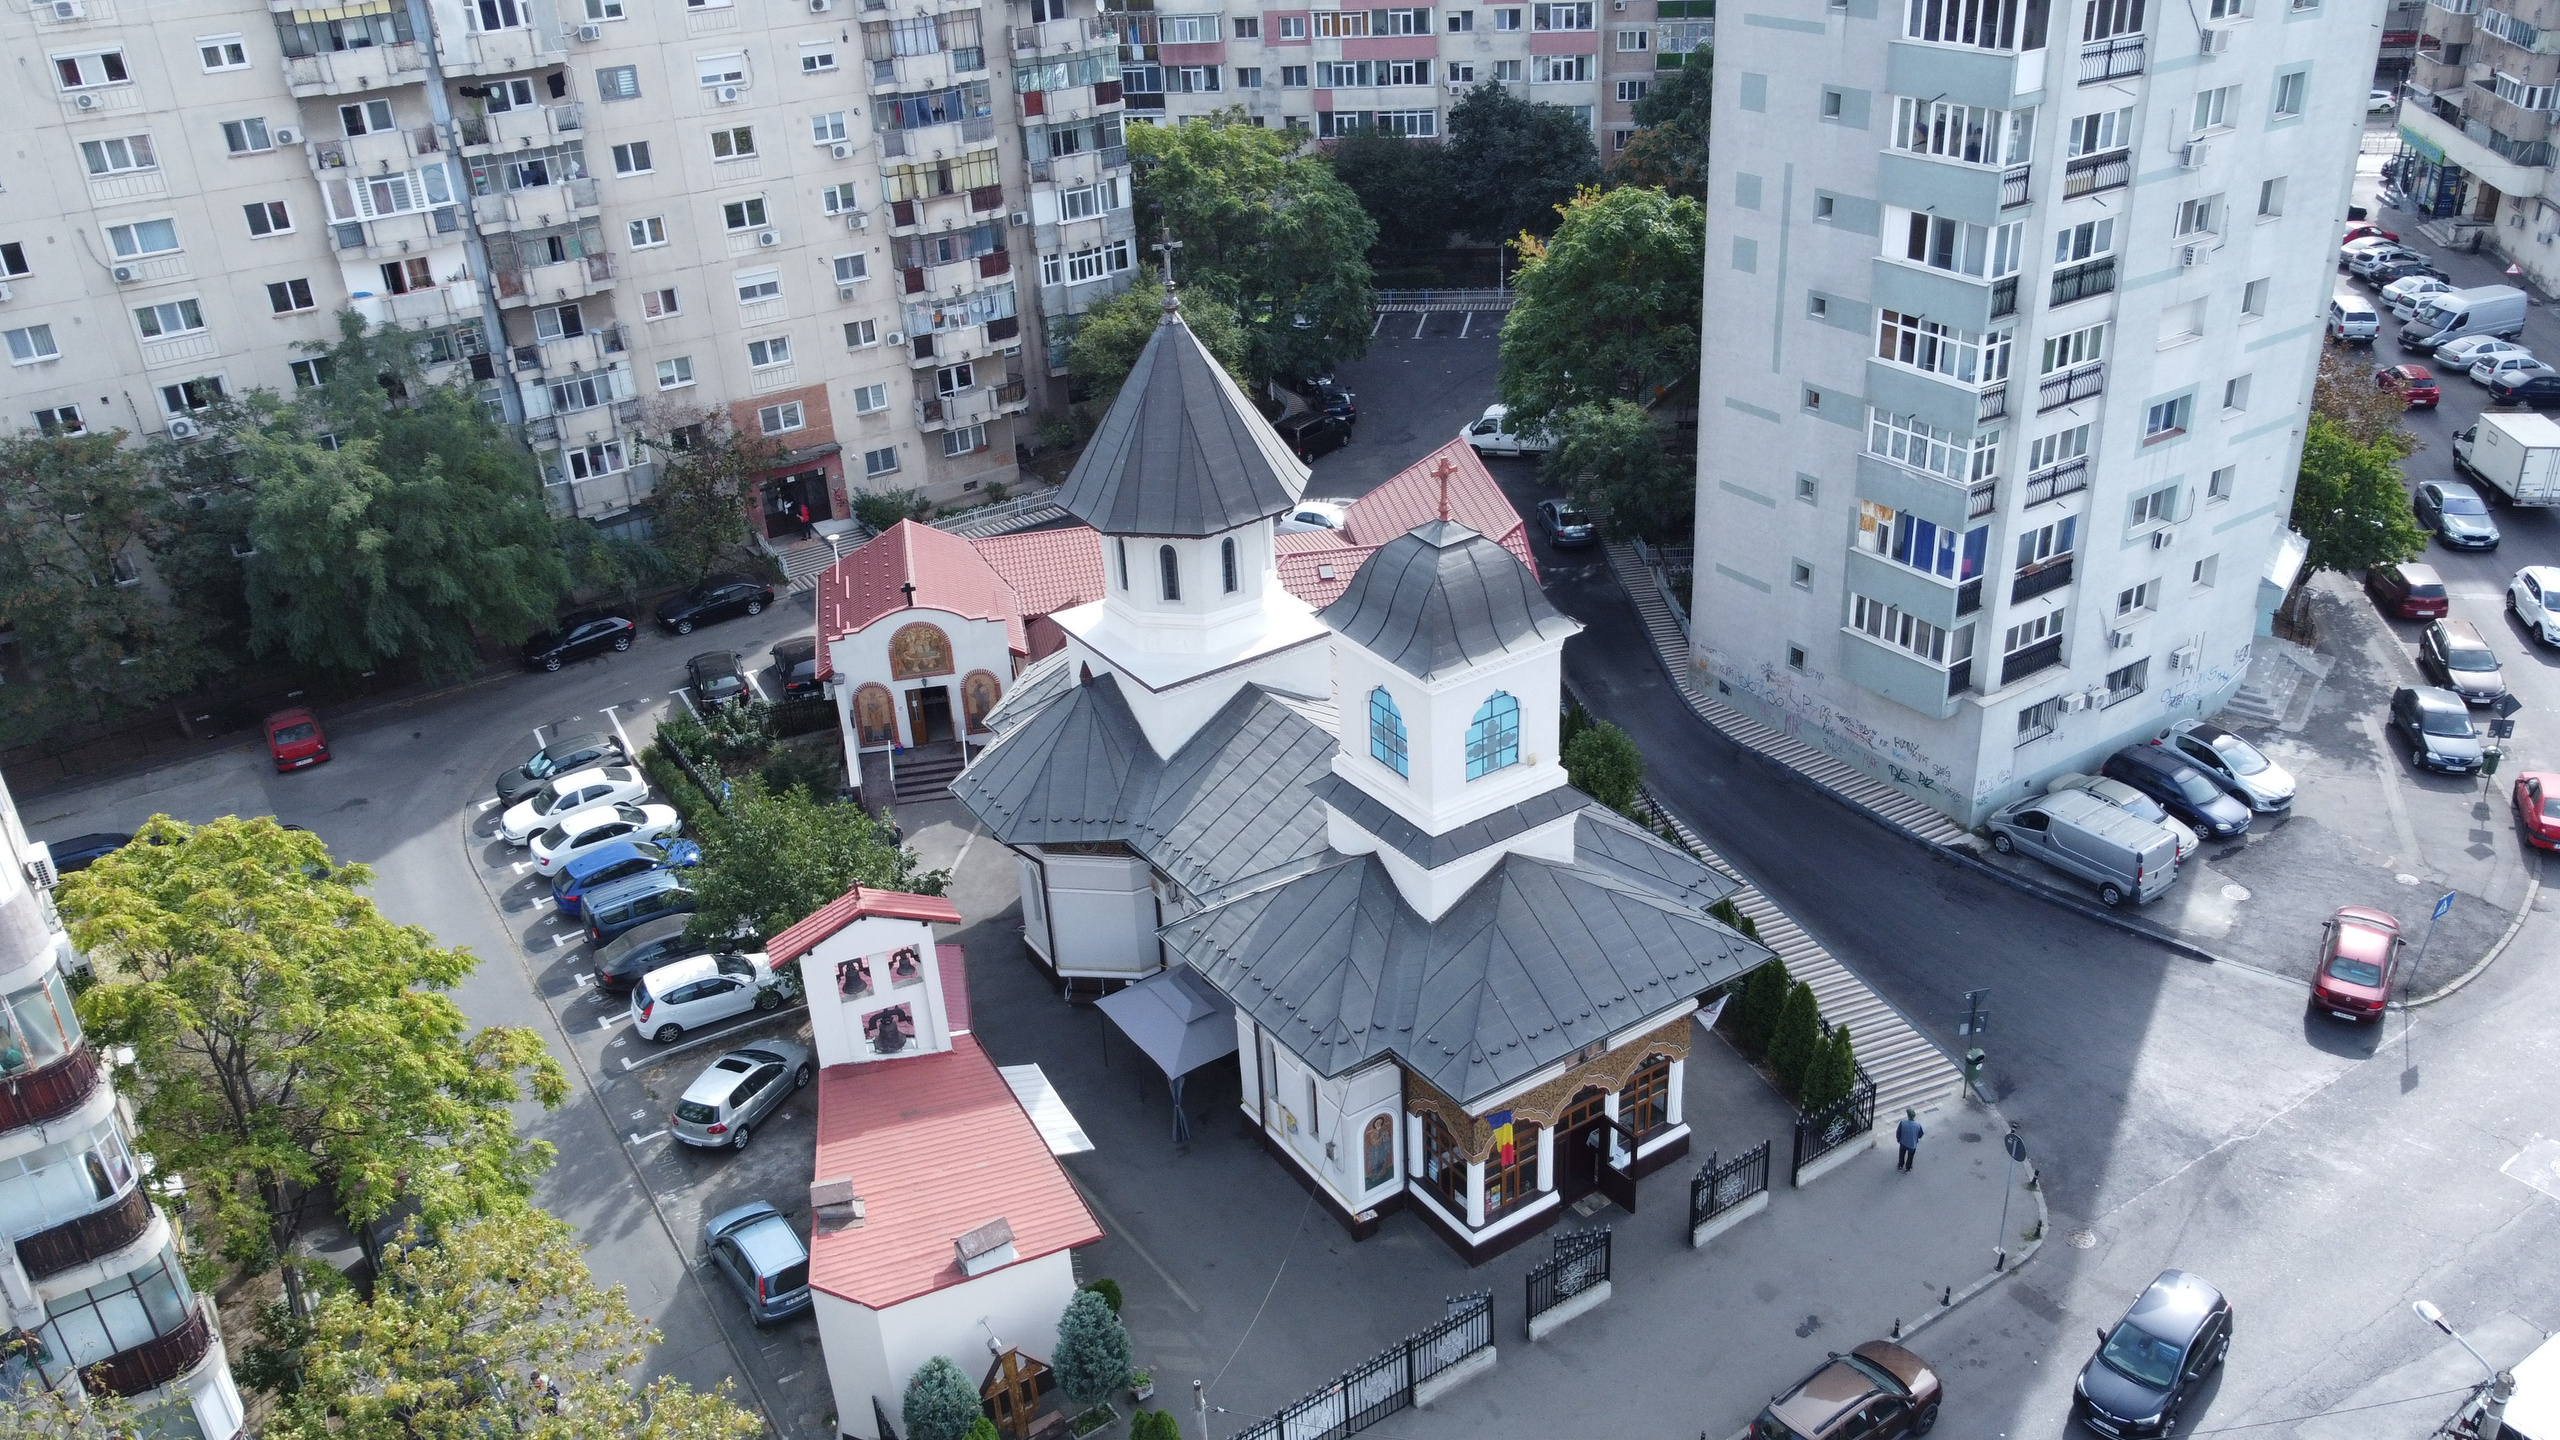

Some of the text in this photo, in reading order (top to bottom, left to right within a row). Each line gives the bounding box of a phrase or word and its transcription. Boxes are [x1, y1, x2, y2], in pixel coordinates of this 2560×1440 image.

[487, 816, 500, 825] 12
[505, 847, 518, 855] 13
[524, 881, 537, 890] 14
[543, 914, 558, 926] 15
[566, 954, 580, 964] 16
[612, 1037, 627, 1048] 18
[630, 1109, 647, 1120] 19
